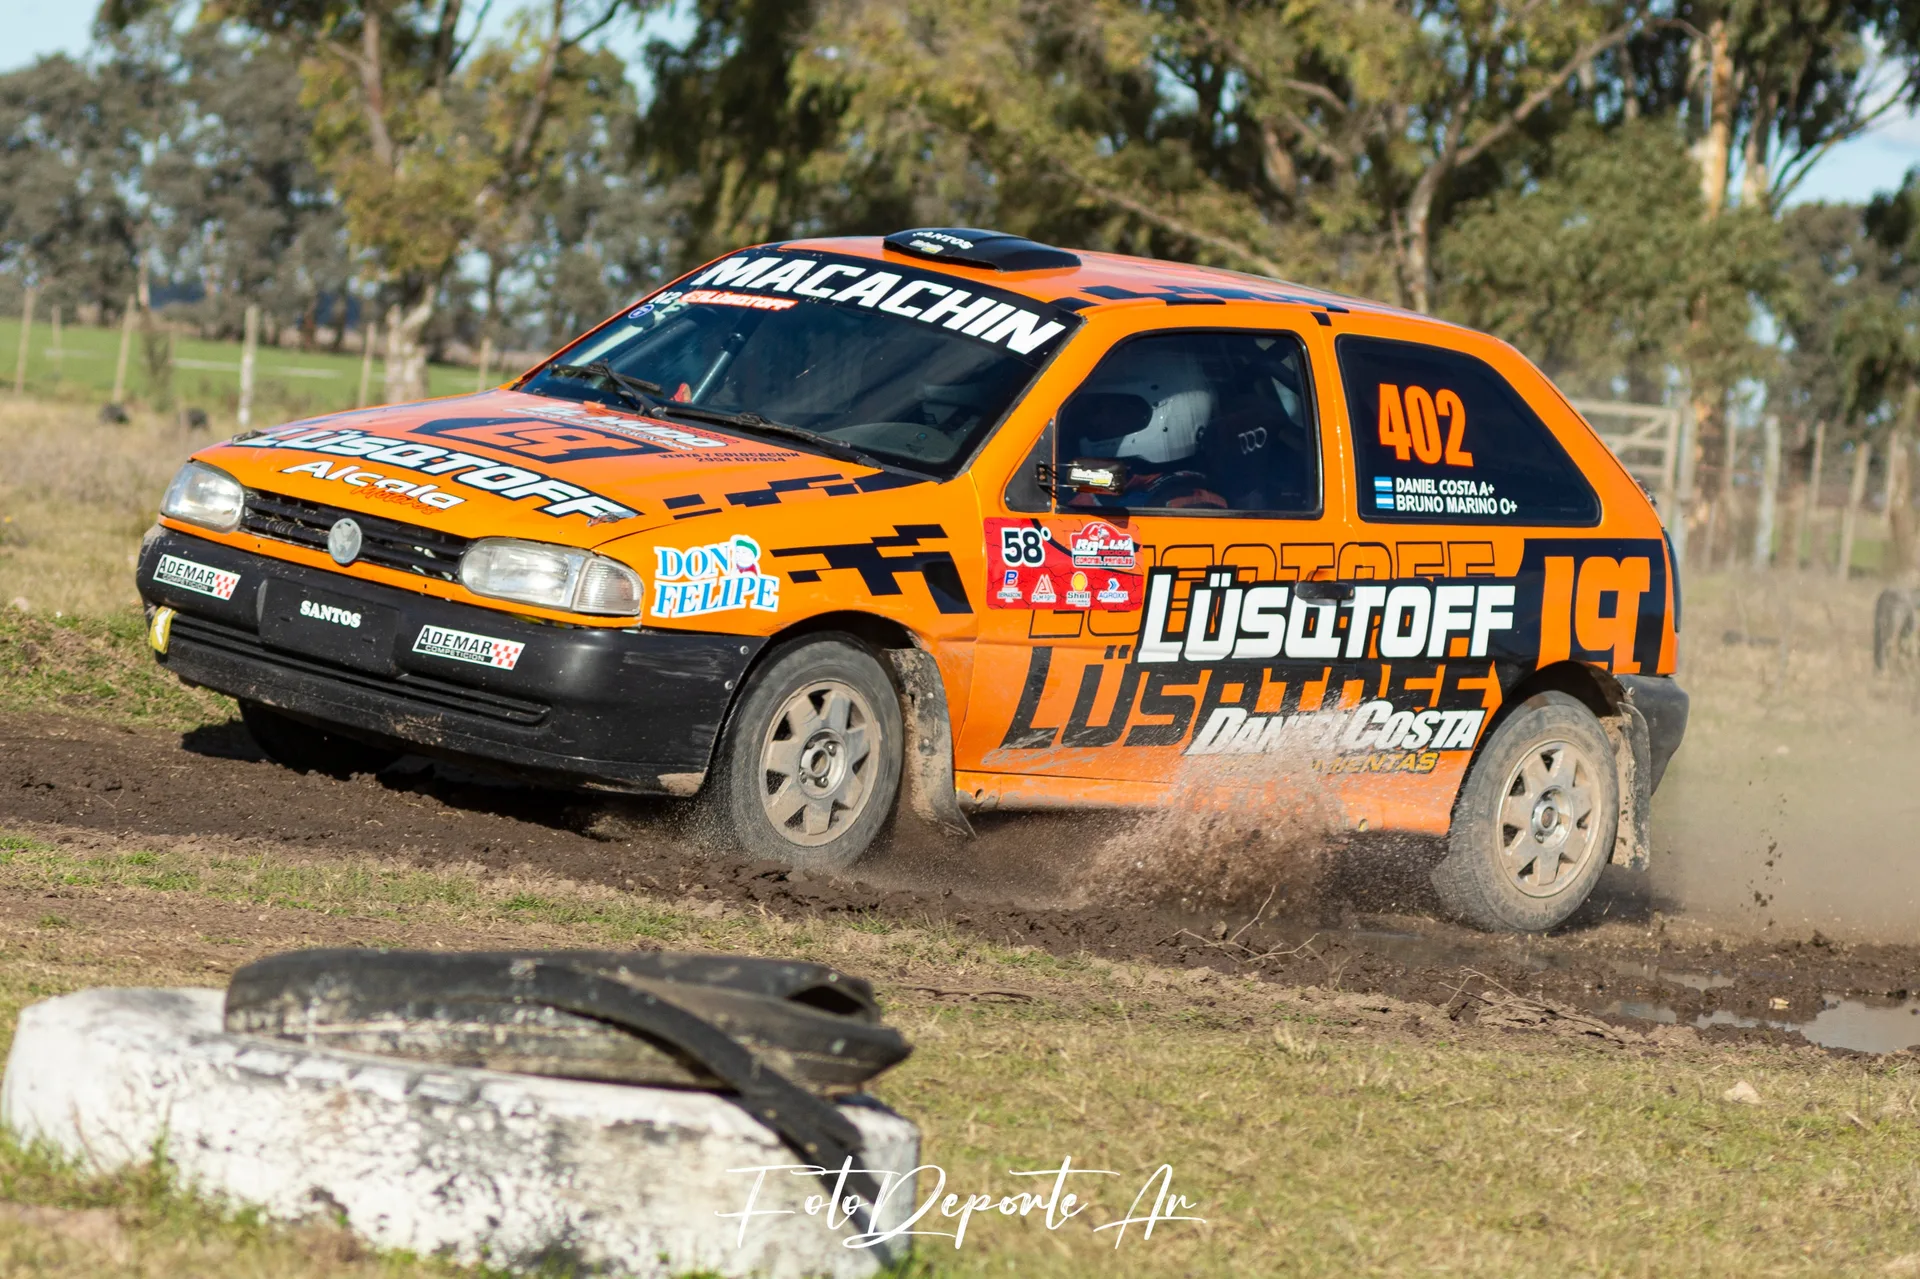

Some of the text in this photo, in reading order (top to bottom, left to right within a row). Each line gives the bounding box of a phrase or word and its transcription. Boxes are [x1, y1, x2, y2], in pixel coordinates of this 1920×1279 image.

[690, 256, 1066, 355] MACACHIN
[1379, 383, 1474, 467] 402
[281, 460, 467, 509] Alcala
[1396, 477, 1495, 496] DANIEL COSTA A+
[1396, 495, 1444, 512] BRUNO
[1445, 496, 1498, 514] MARINO
[1075, 538, 1132, 551] RALLY
[158, 556, 216, 585] ADEMAR
[659, 544, 731, 579] DON
[654, 576, 779, 615] FELIPE
[300, 600, 362, 629] SANTOS
[1137, 573, 1515, 663] LÜSQTOFF
[420, 627, 493, 655] ADEMAR
[424, 645, 486, 662] COMPETICION
[1347, 700, 1486, 751] COSTA
